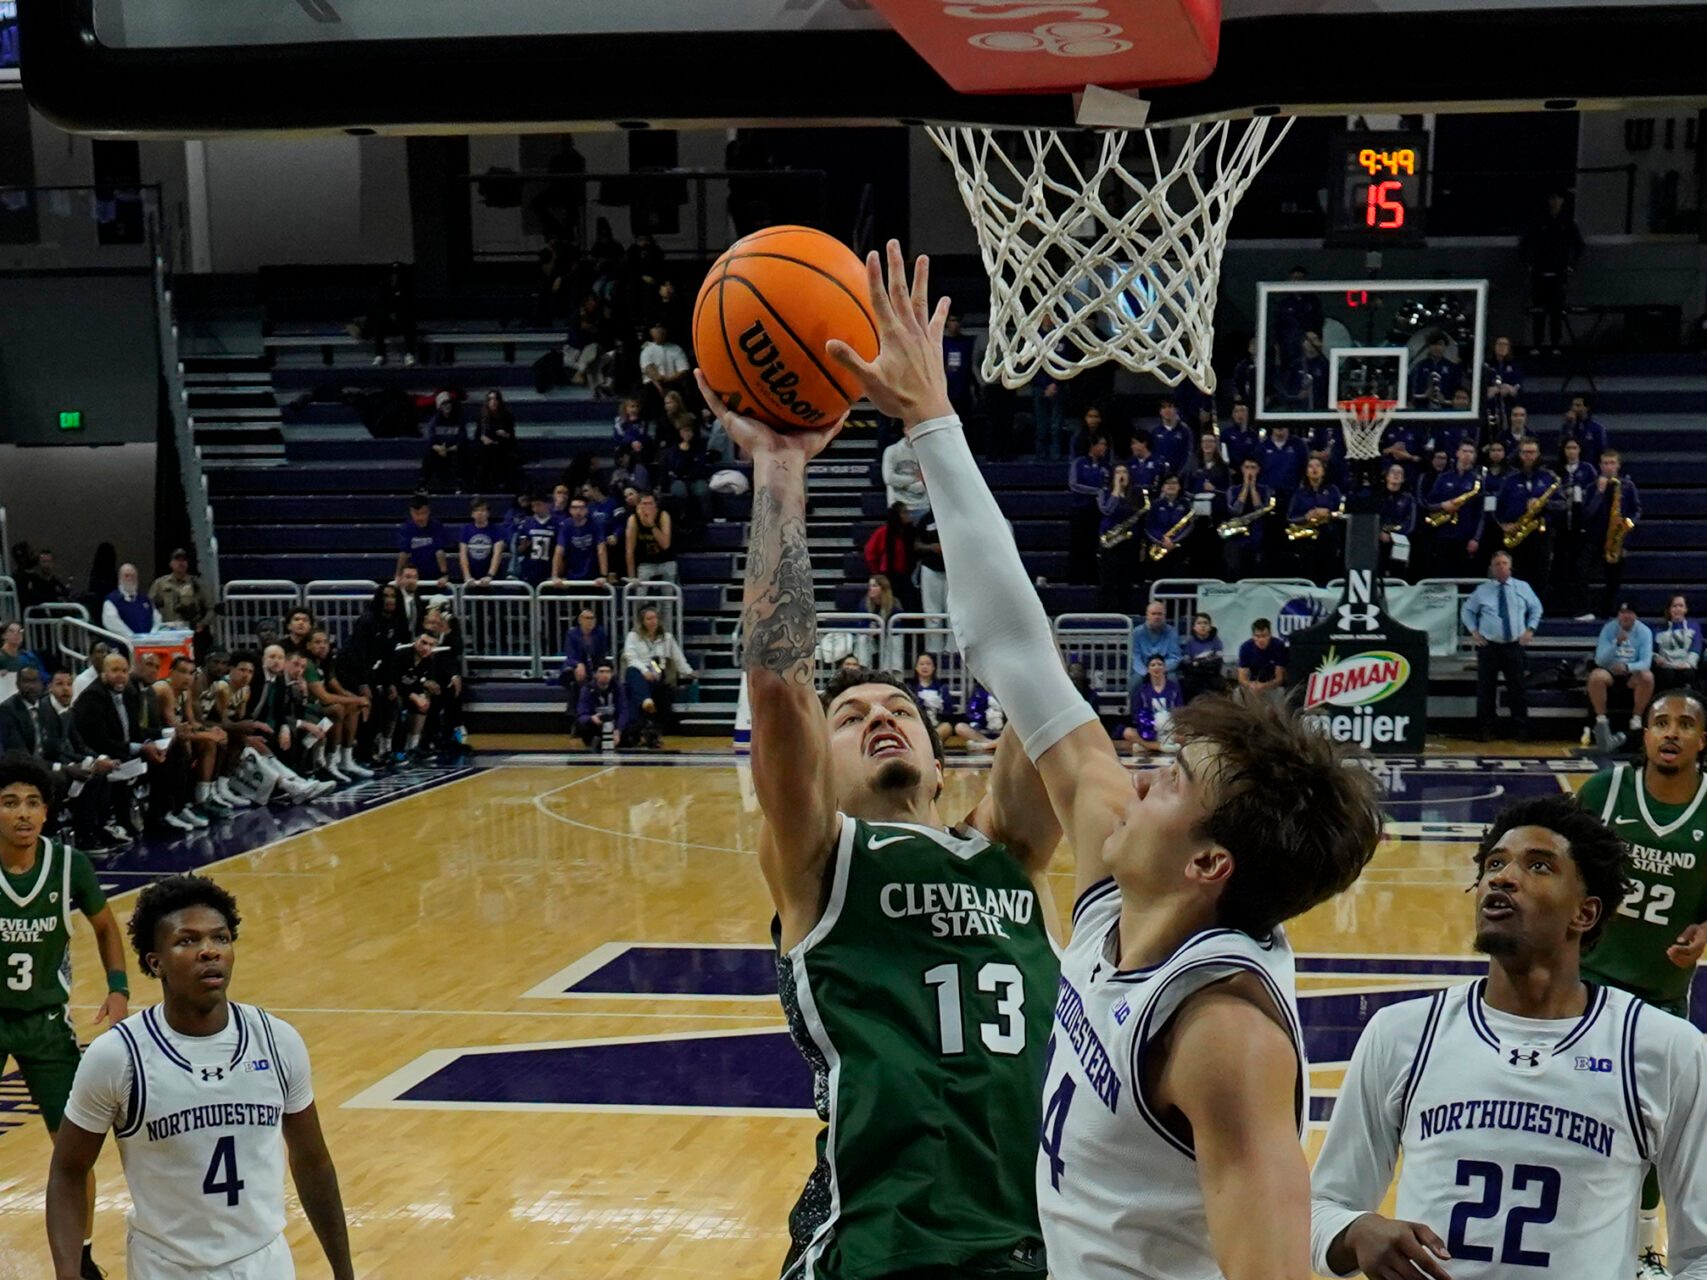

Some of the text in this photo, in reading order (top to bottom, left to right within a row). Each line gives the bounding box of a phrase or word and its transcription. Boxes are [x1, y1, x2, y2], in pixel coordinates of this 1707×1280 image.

[1358, 148, 1416, 177] 9:49
[1366, 181, 1405, 230] 15
[738, 319, 826, 425] Wilson
[531, 536, 551, 561] 51
[1348, 569, 1372, 604] N
[1305, 658, 1401, 709] LIBMAN
[1302, 704, 1410, 750] meijer
[1624, 842, 1697, 870] EVELAND
[1632, 858, 1674, 877] STATE
[879, 882, 1034, 927] CLEVELAND
[1616, 876, 1676, 926] 22
[0, 915, 58, 933] EVELAND
[1, 931, 44, 943] STATE
[931, 911, 1010, 941] STATE
[6, 952, 34, 992] 3
[924, 962, 1027, 1057] 13
[1053, 975, 1122, 1115] HWESTERN
[146, 1103, 283, 1142] NORTHWESTERN
[1420, 1099, 1616, 1158] NORTHWESTERN
[202, 1135, 245, 1208] 4
[1447, 1158, 1562, 1268] 22
